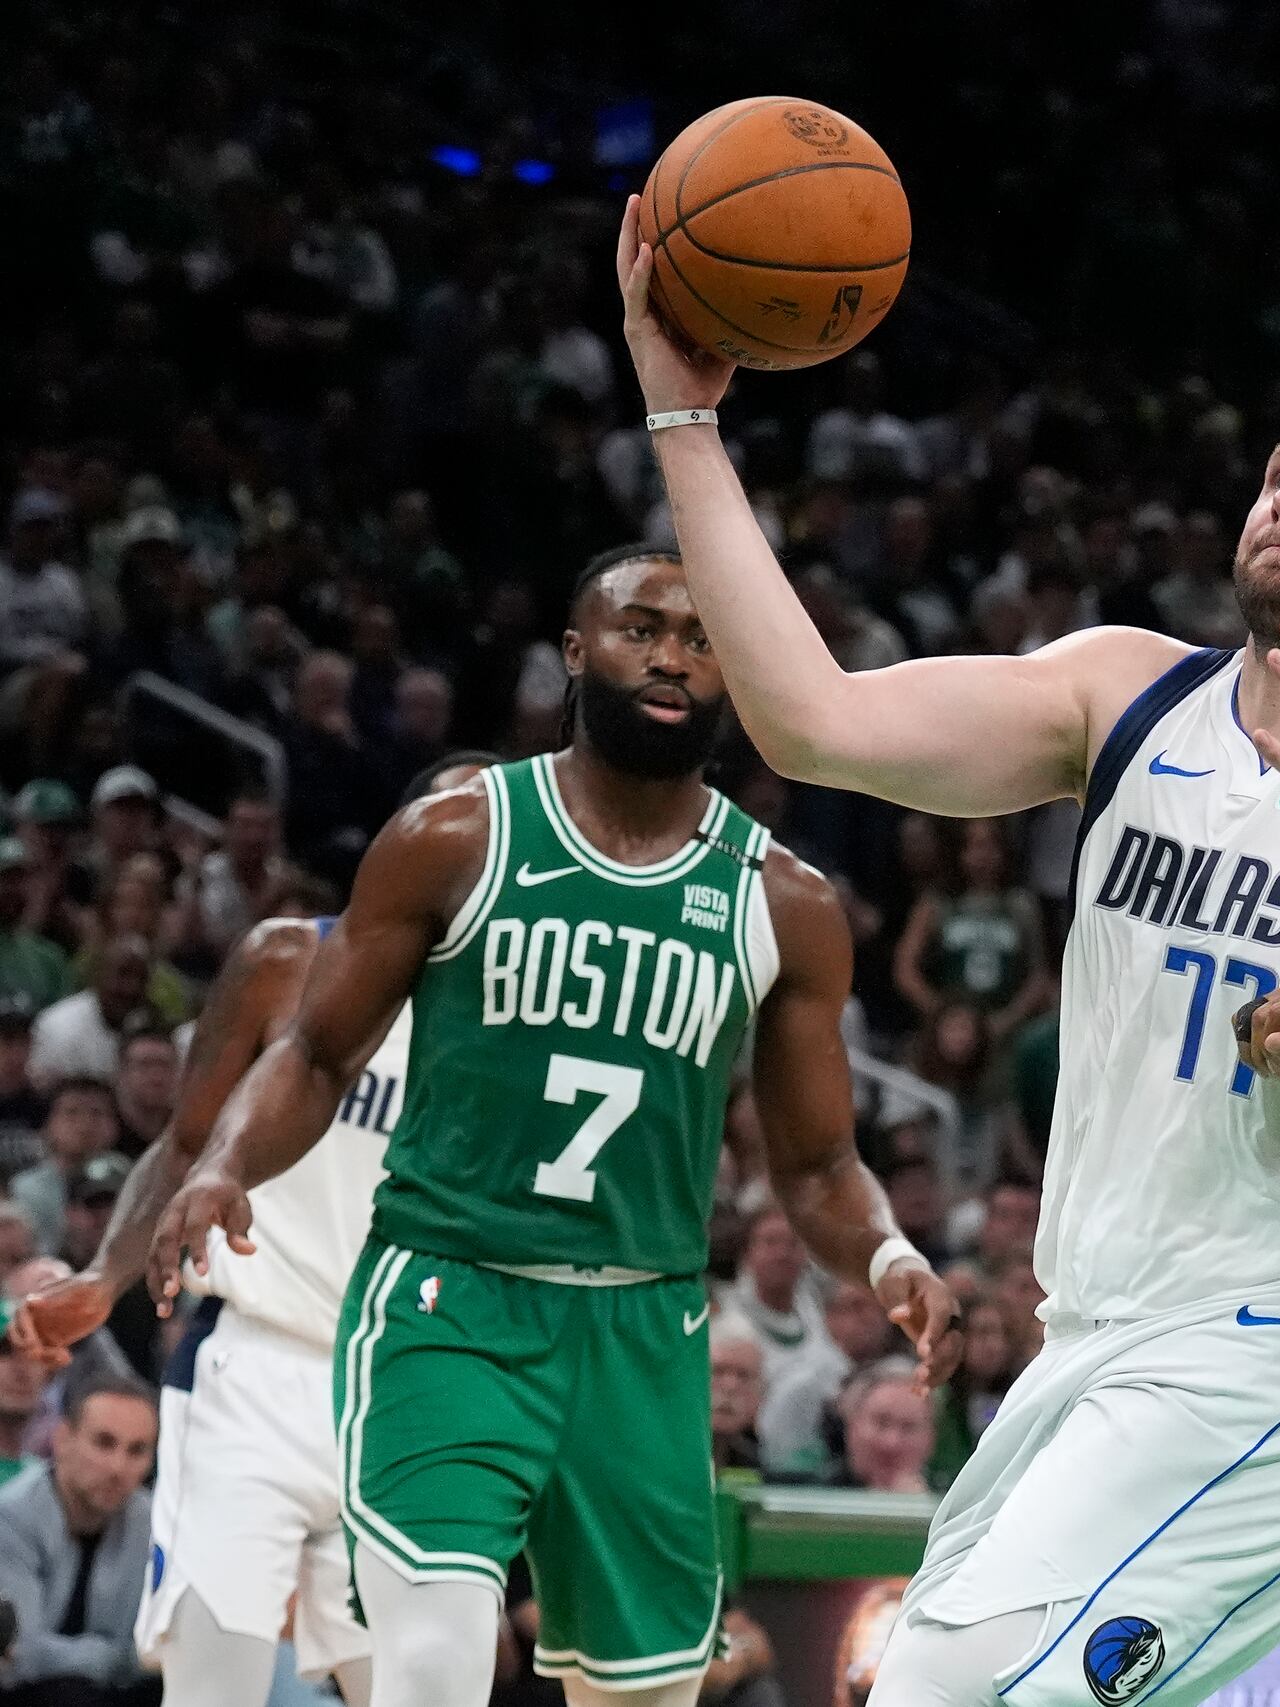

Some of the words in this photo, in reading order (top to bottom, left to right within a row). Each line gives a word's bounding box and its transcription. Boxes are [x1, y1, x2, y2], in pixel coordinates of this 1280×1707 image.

[682, 905, 728, 932] PRINT
[684, 884, 729, 915] VISTA
[483, 917, 735, 1068] BOSTON
[533, 1053, 644, 1202] 7
